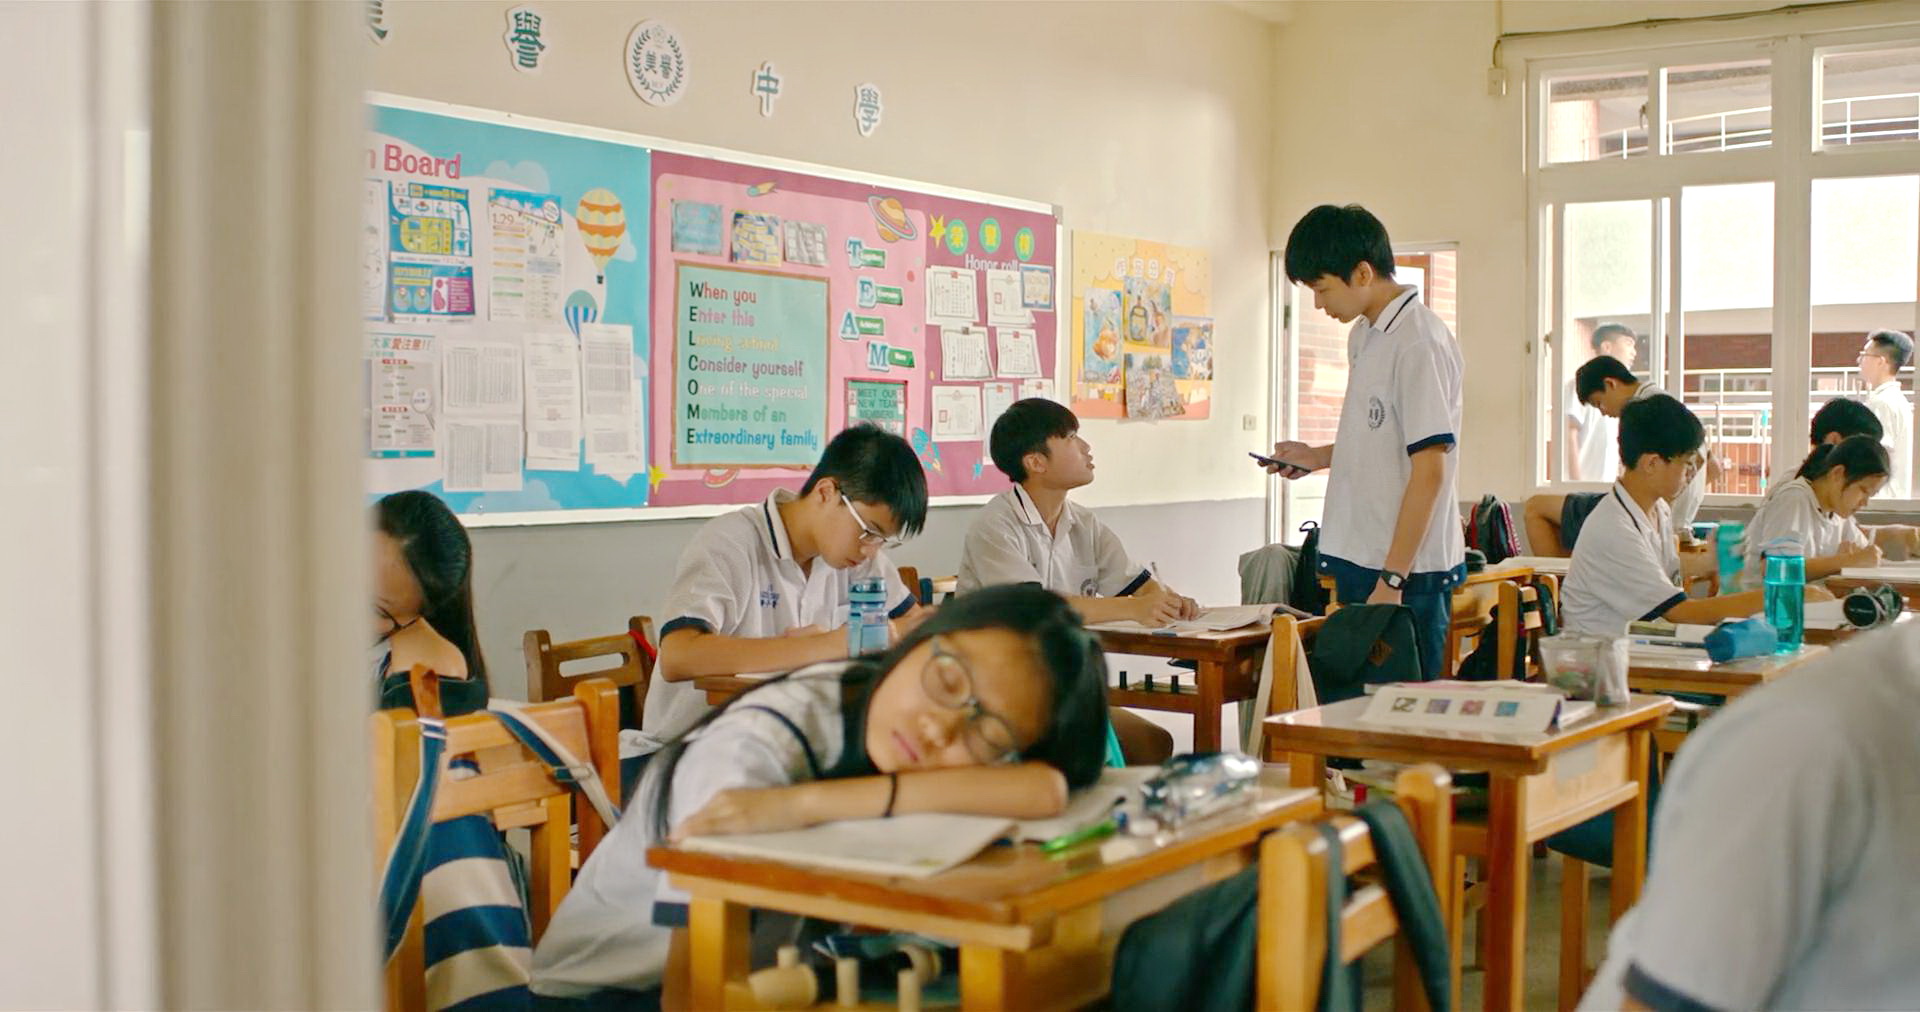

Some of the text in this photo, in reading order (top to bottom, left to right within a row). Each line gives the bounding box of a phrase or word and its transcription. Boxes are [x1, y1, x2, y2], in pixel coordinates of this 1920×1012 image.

[511, 10, 880, 132] 譽 中 學
[384, 144, 461, 179] Board
[965, 254, 997, 271] Honor
[690, 281, 757, 306] When you
[689, 306, 755, 327] Enter this
[841, 312, 857, 334] A
[869, 343, 887, 366] M
[688, 354, 804, 379] Consider yourself
[687, 379, 808, 401] One of the special
[687, 403, 787, 422] Members of an
[687, 428, 818, 451] Extraordinary family
